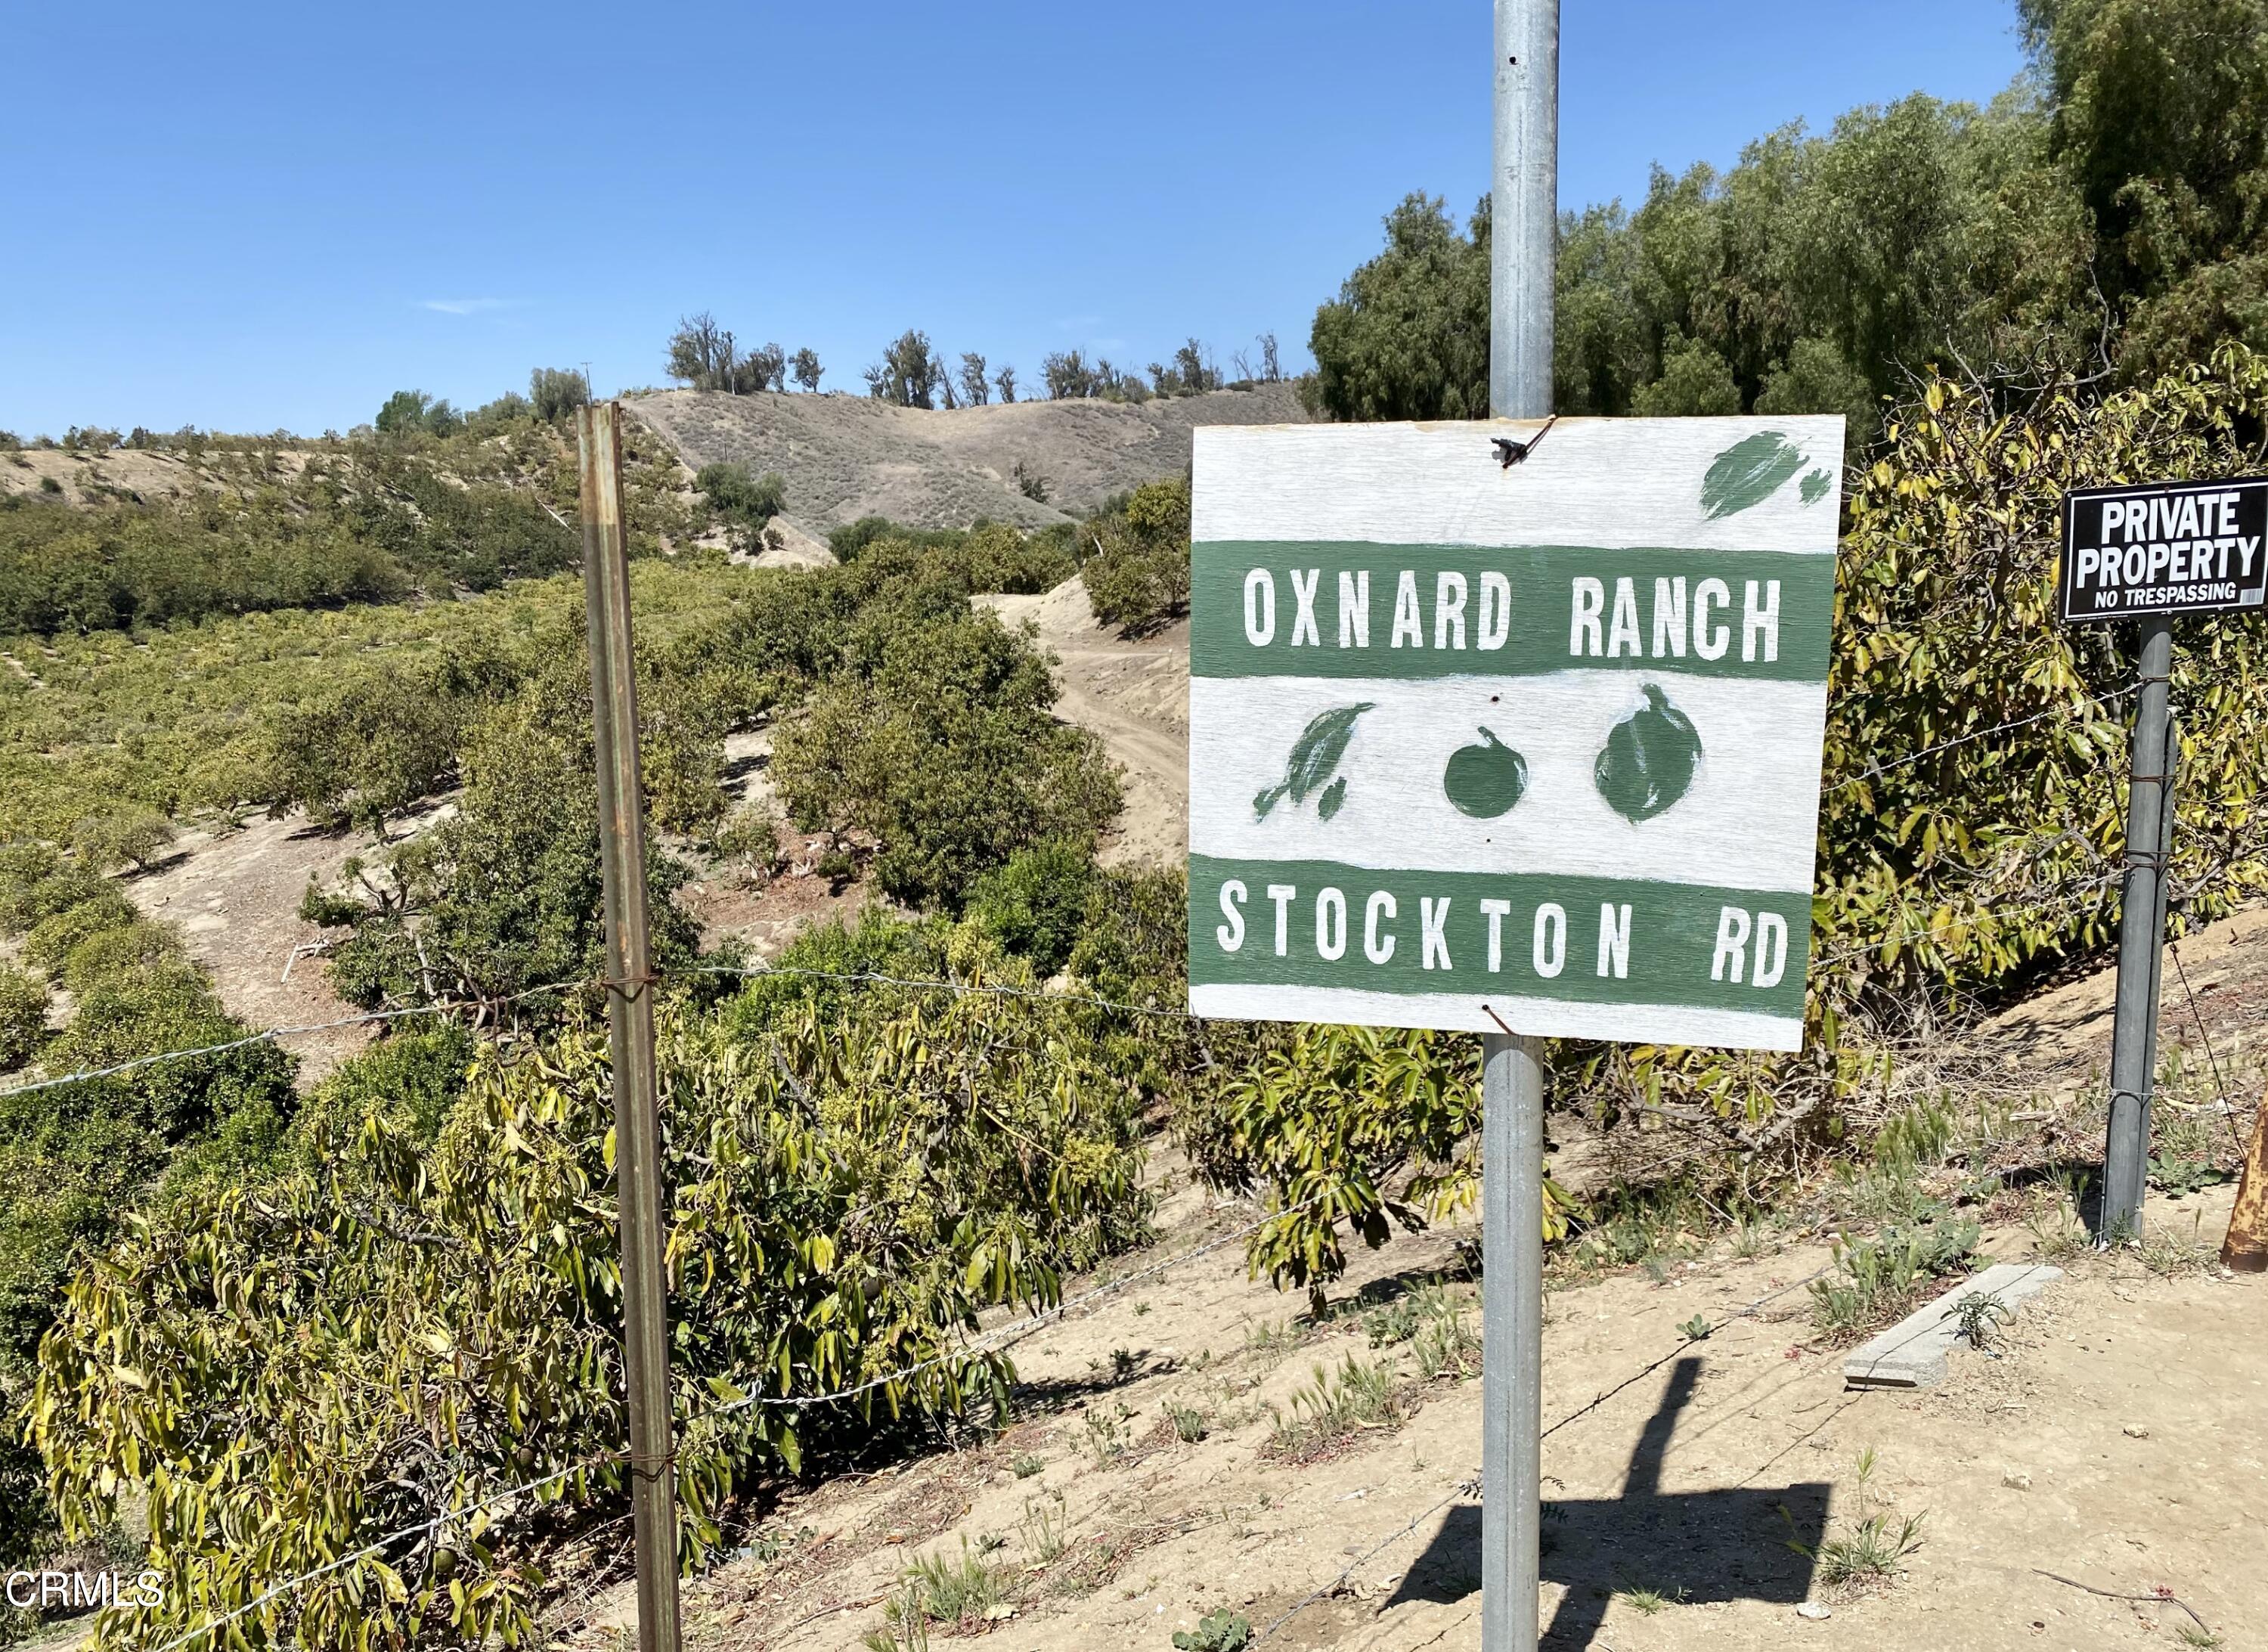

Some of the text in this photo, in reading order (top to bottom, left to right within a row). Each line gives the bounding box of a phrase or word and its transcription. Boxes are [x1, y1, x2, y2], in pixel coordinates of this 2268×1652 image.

[2101, 491, 2241, 544] PRIVATE
[2076, 535, 2261, 589] PROPERTY
[1244, 568, 1781, 662] OXNARD RANCH
[2095, 582, 2236, 609] NO TRESPASSING
[1216, 880, 1789, 988] STOCKTON RD
